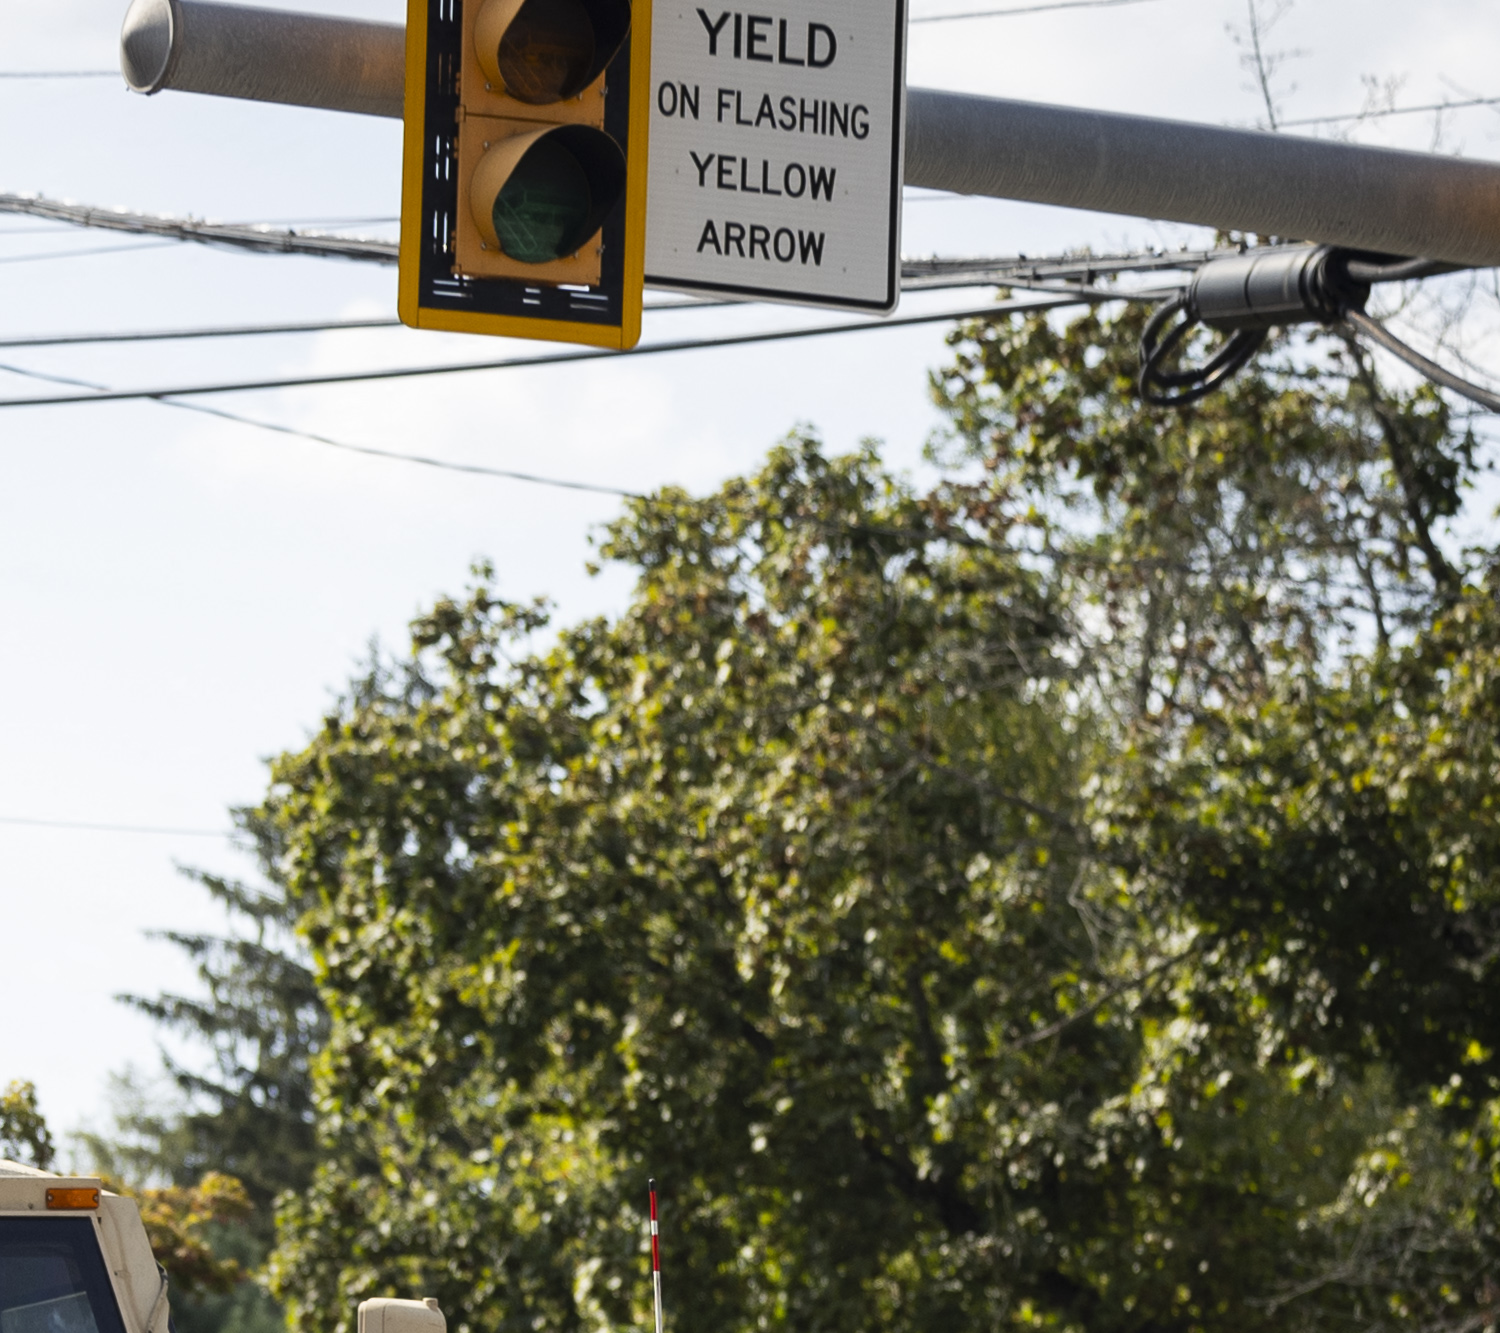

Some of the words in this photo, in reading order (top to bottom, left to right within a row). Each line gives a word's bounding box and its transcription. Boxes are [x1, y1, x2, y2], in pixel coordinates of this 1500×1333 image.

[696, 8, 837, 69] YIELD
[657, 80, 700, 121] ON
[716, 87, 870, 140] FLASHING
[688, 150, 836, 202] YELLOW
[696, 219, 826, 267] ARROW
